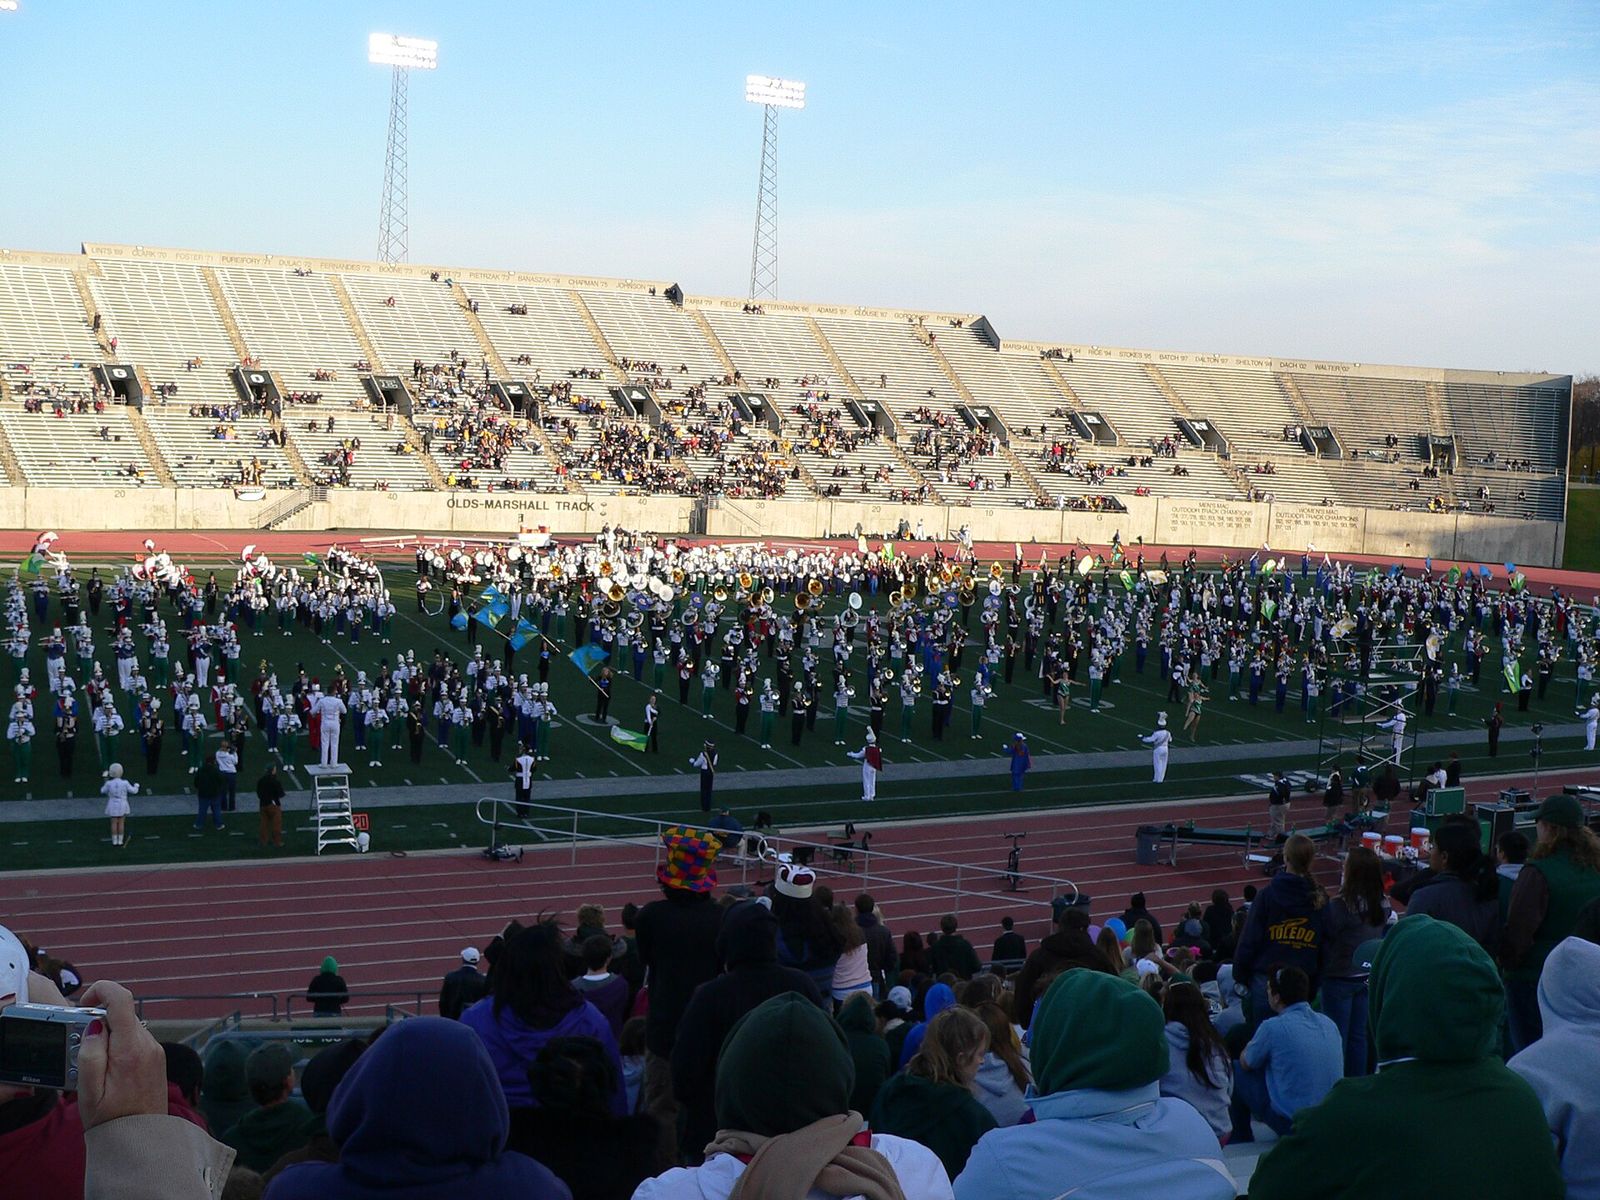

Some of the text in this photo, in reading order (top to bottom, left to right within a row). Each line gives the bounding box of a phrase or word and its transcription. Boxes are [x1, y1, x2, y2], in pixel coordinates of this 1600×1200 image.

[132, 249, 156, 258] CLARK
[176, 252, 204, 260] FOSTER
[320, 262, 360, 272] FERNANDES
[378, 264, 403, 274] BOONE
[469, 272, 499, 280] PIETRZAK
[518, 275, 550, 283] BANASZAK
[568, 279, 598, 288] CHAPMAN
[616, 282, 646, 290] JOHNSON
[1002, 343, 1034, 352] MARSHALL
[1195, 356, 1218, 364] DALTON
[1236, 359, 1263, 367] SHELTON
[1280, 361, 1298, 369] DACH
[1315, 364, 1340, 372] WALTER
[1192, 422, 1209, 430] N
[447, 499, 595, 512] OLDS-MARSHALL TRACK
[353, 816, 367, 828] 20
[1269, 924, 1316, 942] TOLEDO
